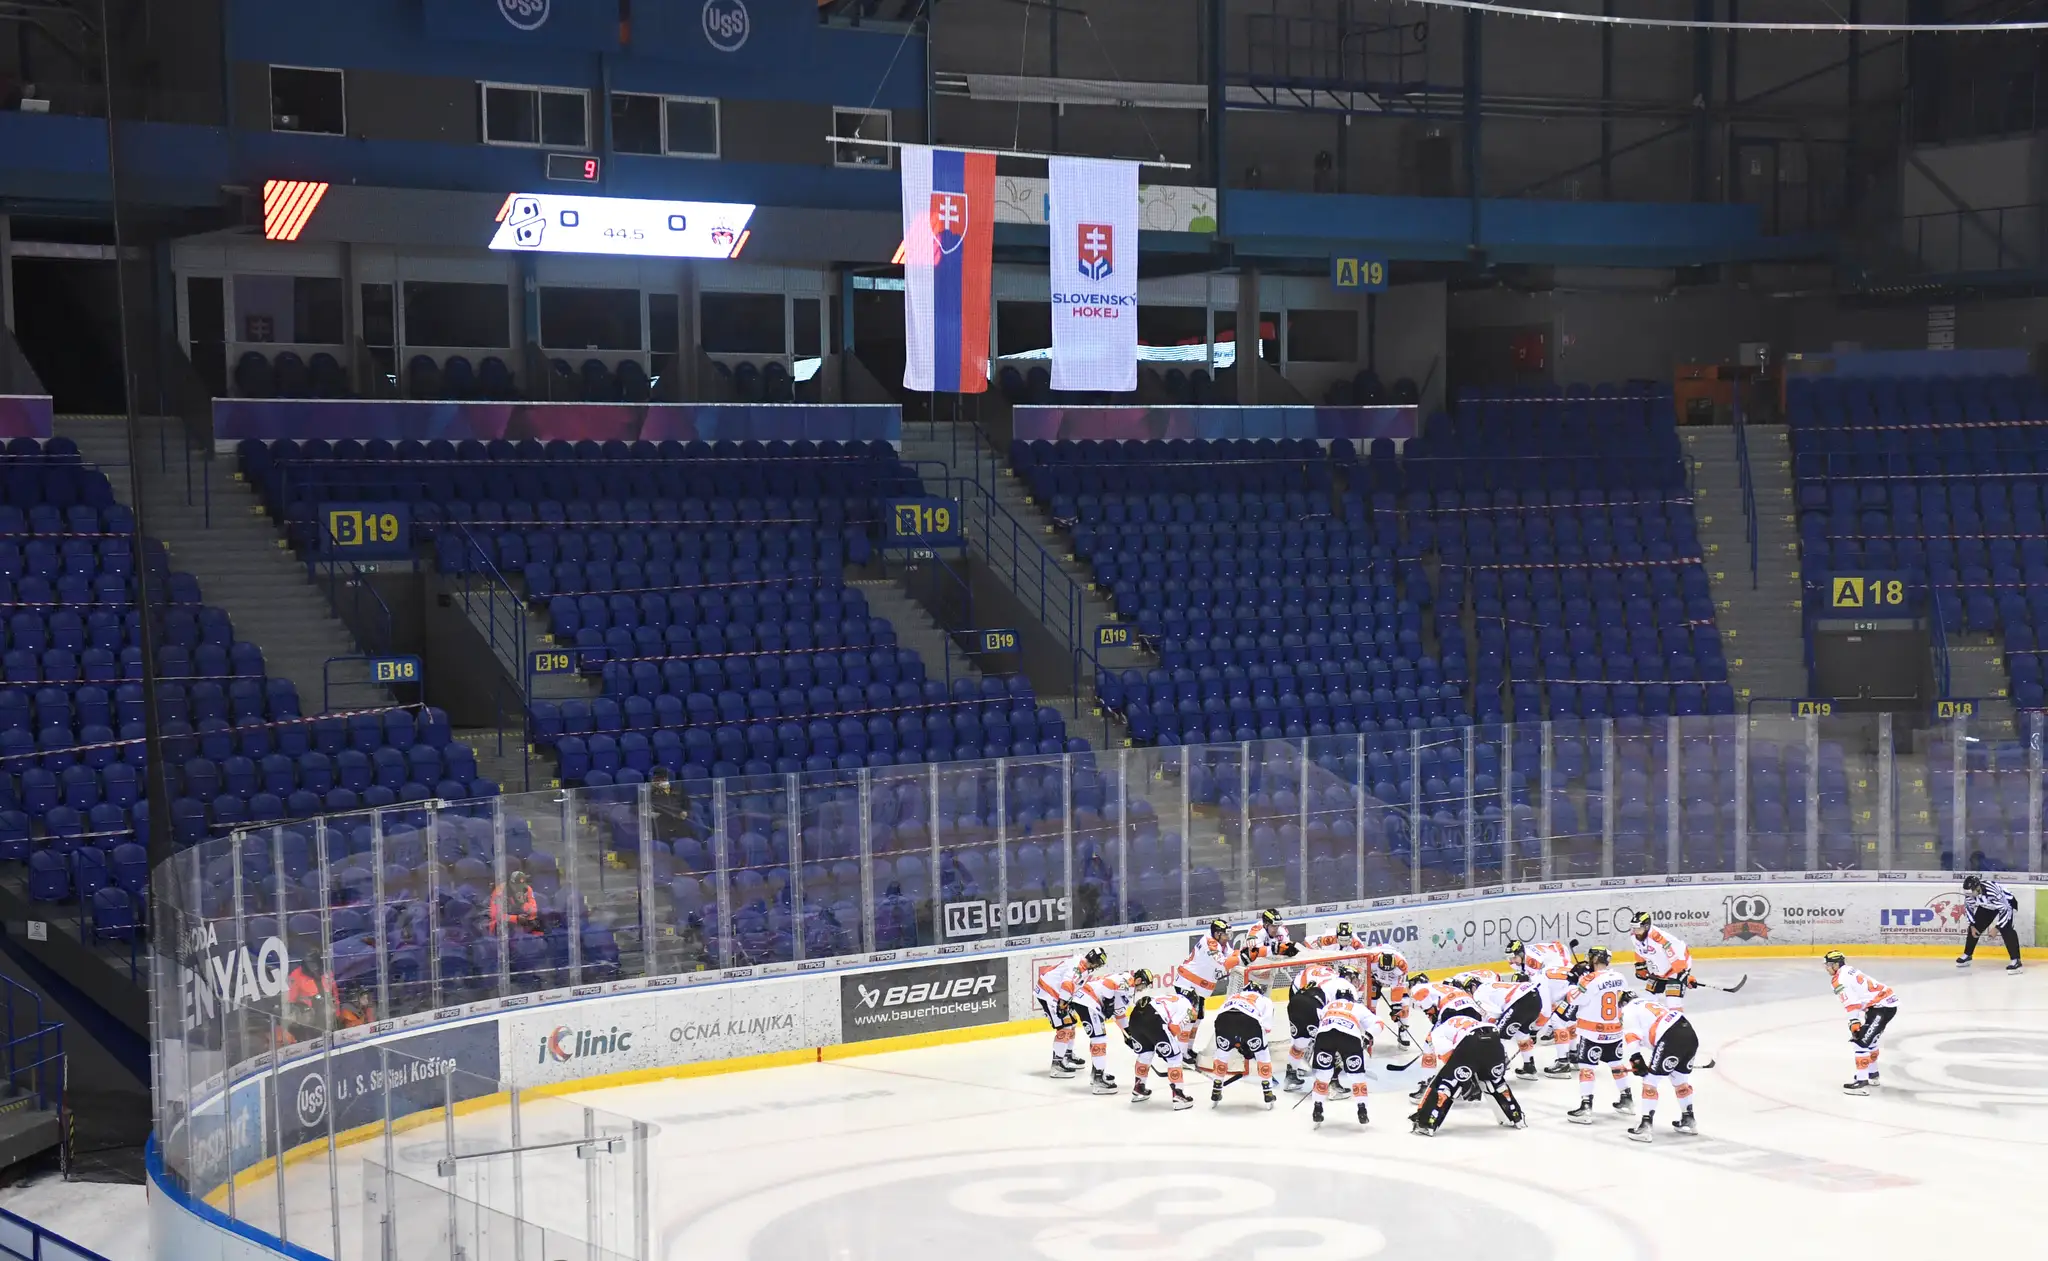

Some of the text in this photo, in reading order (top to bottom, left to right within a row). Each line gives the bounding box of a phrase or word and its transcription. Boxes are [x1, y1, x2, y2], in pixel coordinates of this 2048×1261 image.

[709, 8, 743, 38] USS
[584, 160, 596, 179] 9
[560, 210, 579, 227] 0
[668, 215, 687, 231] 0
[603, 228, 645, 240] 44.5
[1338, 260, 1383, 285] A 19
[1052, 292, 1137, 306] SLOVENSKÝ
[1072, 306, 1119, 319] HOKEJ
[334, 512, 399, 543] B 19
[923, 507, 950, 533] 19
[1836, 579, 1904, 605] A 18
[1000, 634, 1014, 647] 19
[1113, 629, 1127, 642] 19
[395, 663, 414, 677] 18
[552, 654, 569, 669] 19
[1652, 909, 1710, 920] 100 rokov
[1783, 906, 1845, 917] 100 rokov
[1880, 908, 1935, 926] ITP
[883, 975, 997, 1007] BAUER
[854, 998, 997, 1026] www.bauerhockey.sk
[669, 1013, 794, 1043] OČNÁ KLINIKA
[538, 1025, 633, 1065] iClinic
[411, 1056, 457, 1083] Košice
[300, 1086, 323, 1113] USS
